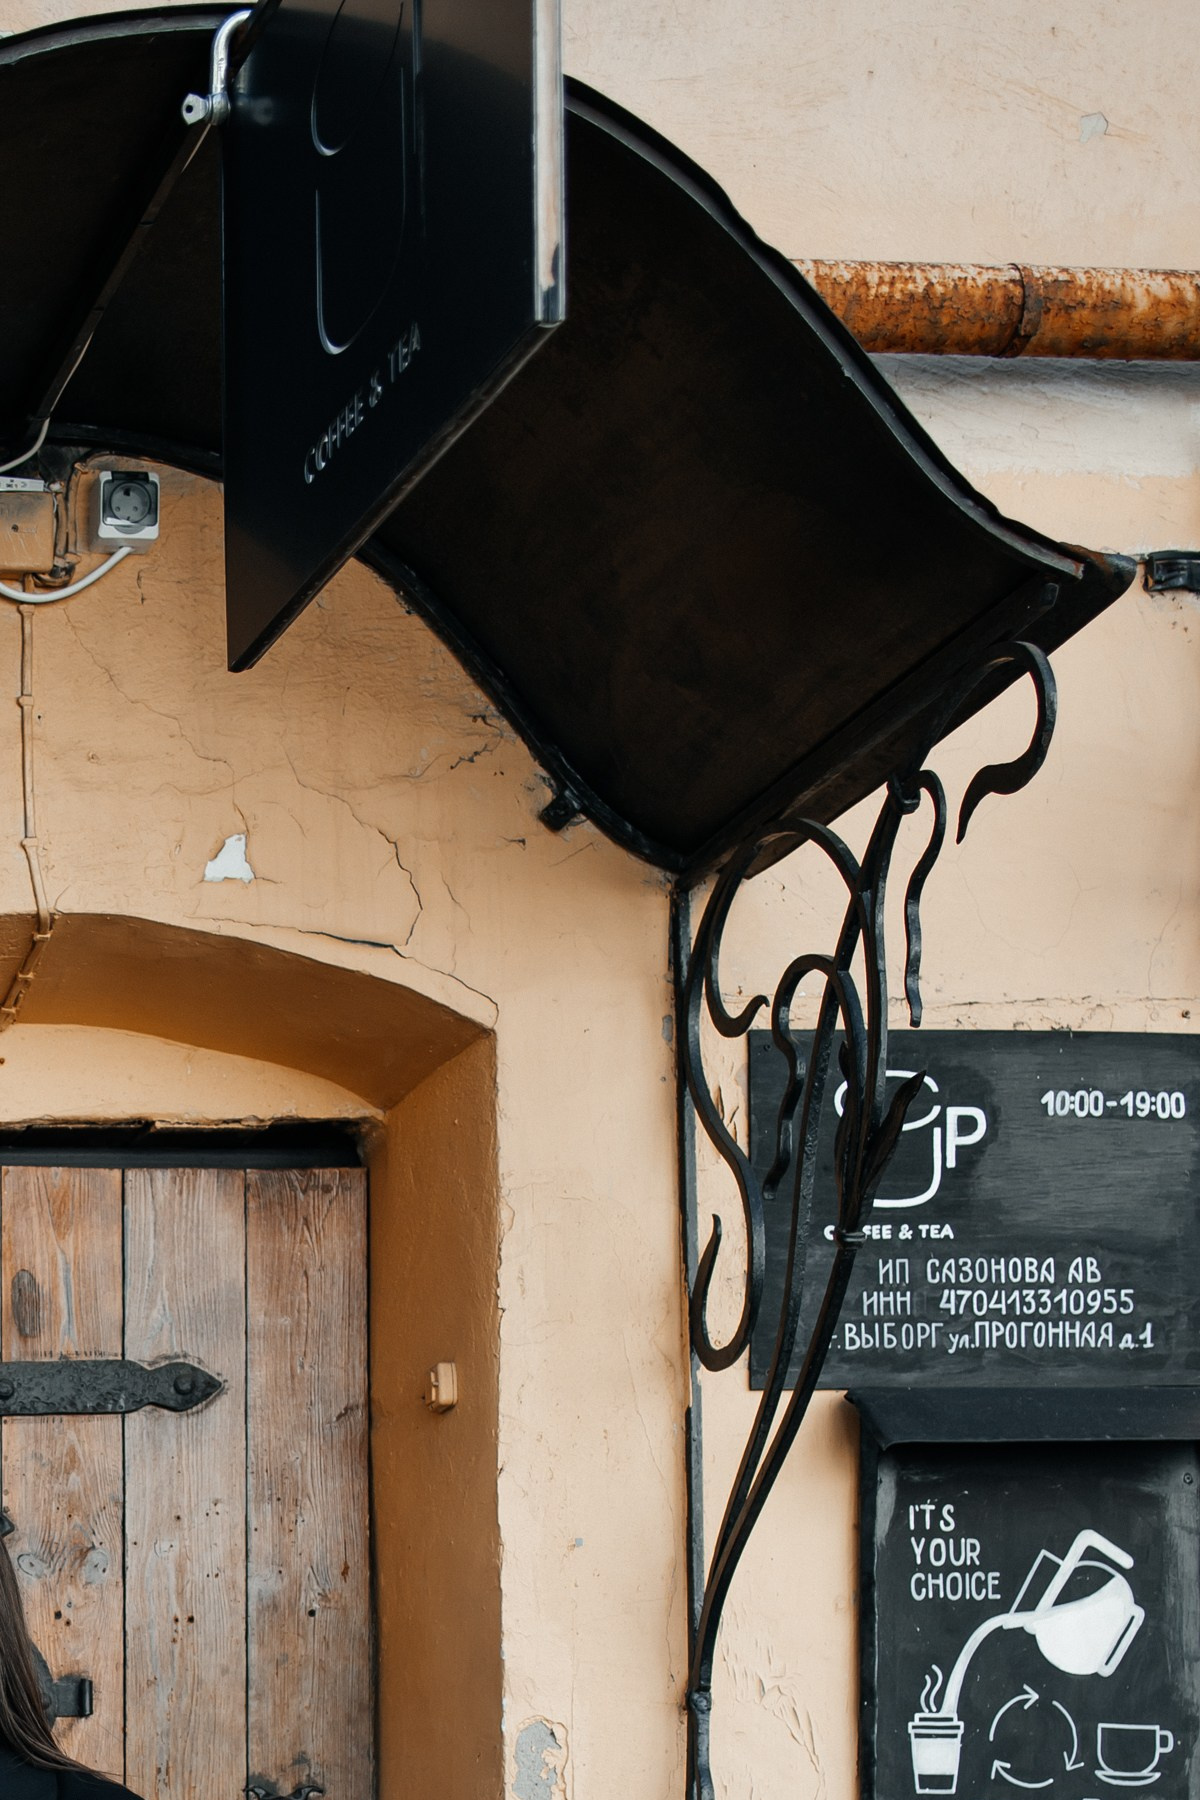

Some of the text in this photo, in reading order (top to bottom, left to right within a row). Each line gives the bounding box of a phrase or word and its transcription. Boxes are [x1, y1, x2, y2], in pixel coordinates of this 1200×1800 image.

[304, 322, 421, 484] COFFEE & TEA
[823, 1224, 954, 1241] CFEE & TEA
[878, 1257, 1101, 1284] ИП САЗОНОВА АВ
[862, 1289, 1134, 1316] ИНН 470413310955
[910, 1536, 981, 1567] YOUR
[910, 1571, 1001, 1601] CHOICE
